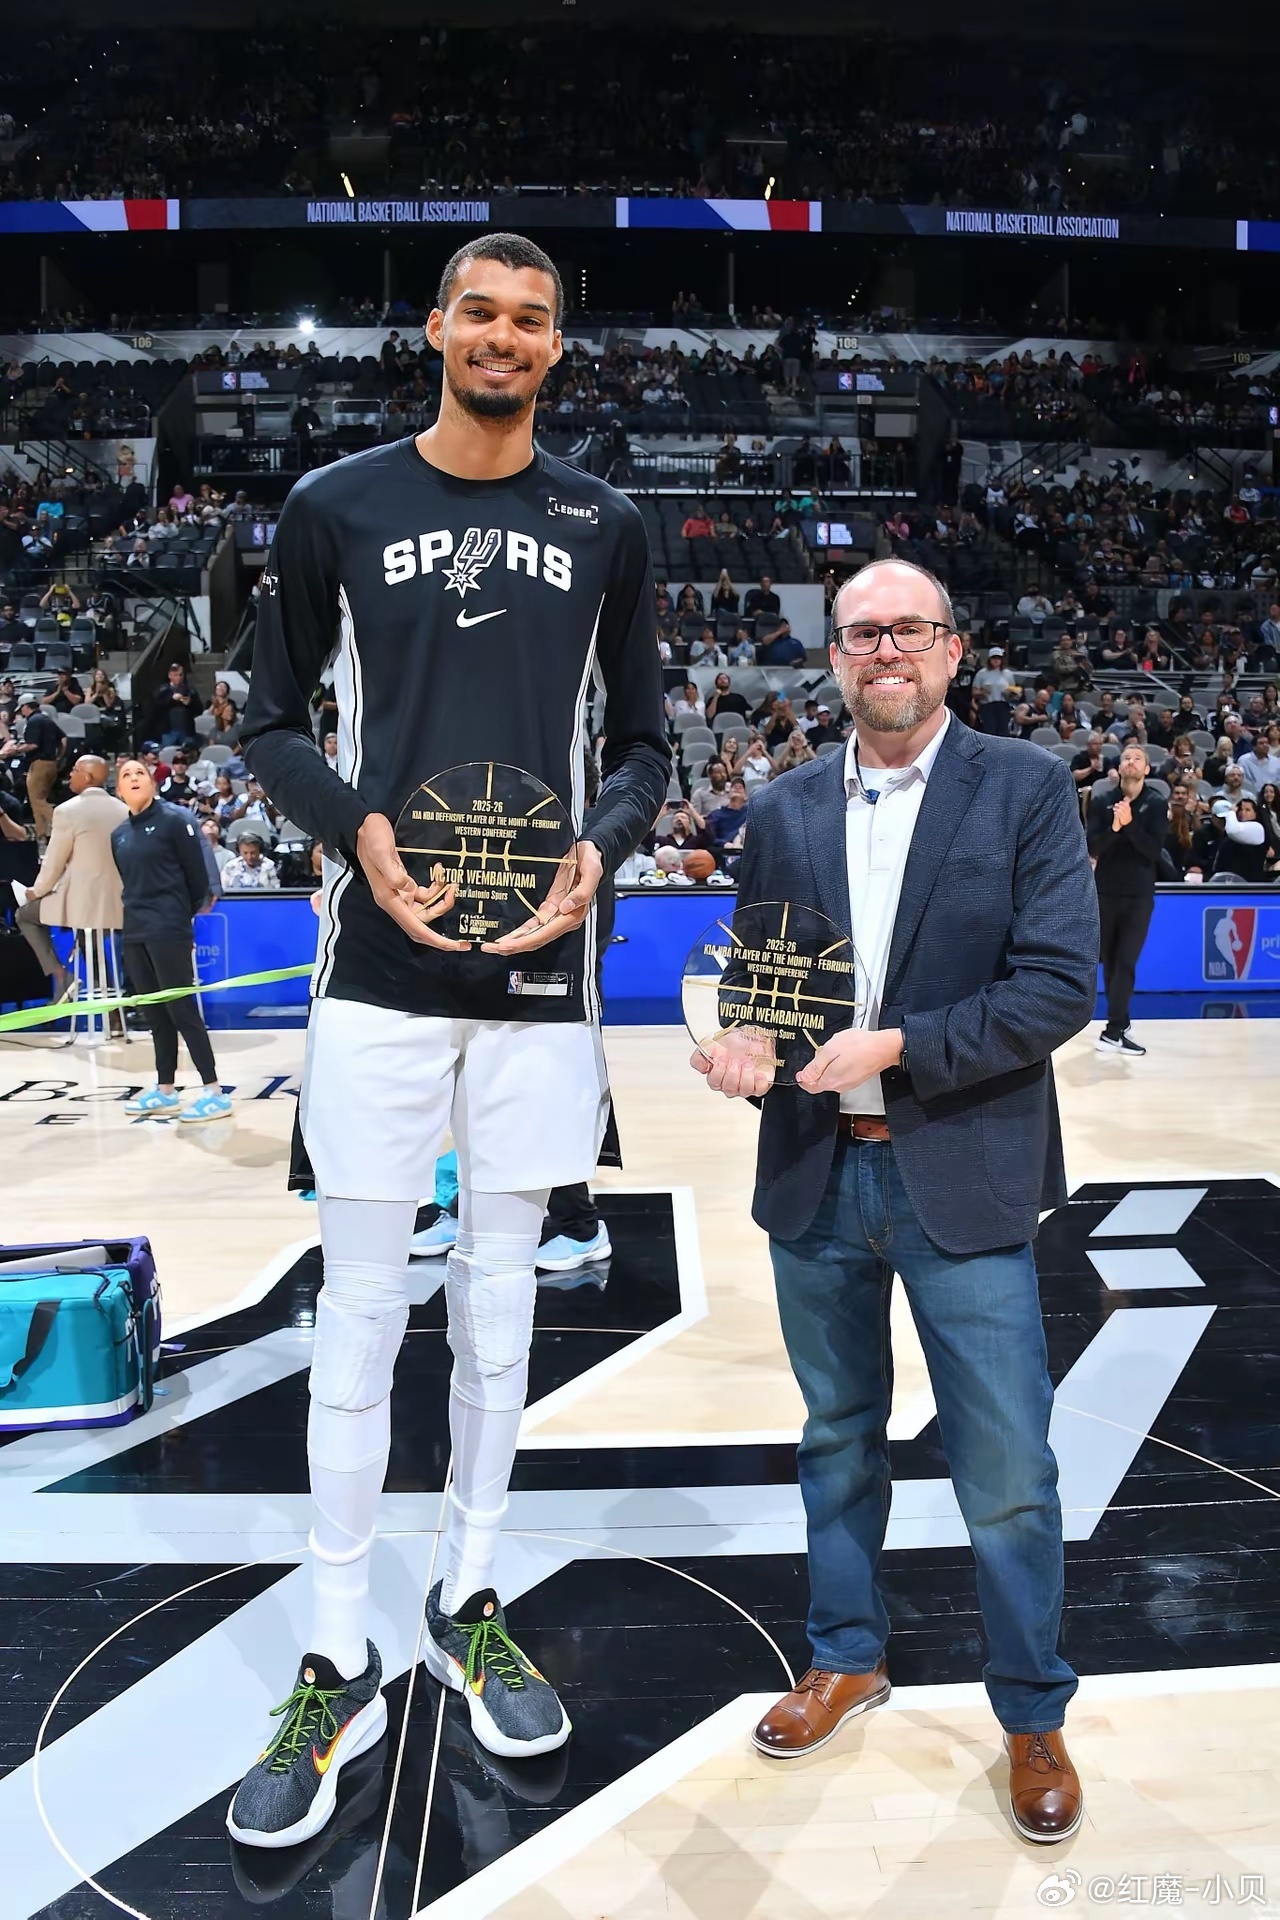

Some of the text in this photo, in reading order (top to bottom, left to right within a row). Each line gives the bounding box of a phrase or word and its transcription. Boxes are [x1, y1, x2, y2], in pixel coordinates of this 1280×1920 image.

[307, 202, 489, 222] NATIONAL BASKETBALL ASSOCIATION
[946, 211, 1119, 238] NATIONAL BASKETBALL ASSOCIATION
[131, 337, 152, 348] 106
[554, 502, 593, 519] LEDGER
[383, 527, 573, 598] SPURS
[472, 799, 504, 813] 2025-26
[412, 810, 422, 820] KIA
[435, 812, 465, 823] DEFENSIVE
[466, 814, 487, 825] PLAYER
[488, 815, 496, 825] OF
[497, 816, 507, 826] THE
[508, 817, 528, 828] MONTH
[532, 819, 561, 830] FEBRUARY
[454, 825, 517, 839] WESTERN CONFERENCE
[466, 869, 536, 889] WEMBANYAMA
[455, 887, 508, 901] San Antonio Spurs
[765, 938, 797, 953] 2025-26
[703, 943, 715, 955] KIA
[733, 948, 761, 961] PLAYER
[762, 951, 771, 963] OF
[772, 953, 786, 965] THE
[787, 955, 813, 969] MONTH
[818, 958, 855, 974] FEBRUARY
[747, 963, 809, 980] WESTERN CONFERENCE
[1208, 961, 1227, 977] NBA
[719, 1002, 825, 1030] VICTOR WEMBANYAMA
[778, 1028, 796, 1040] Spurs
[0, 1075, 300, 1102] Bak
